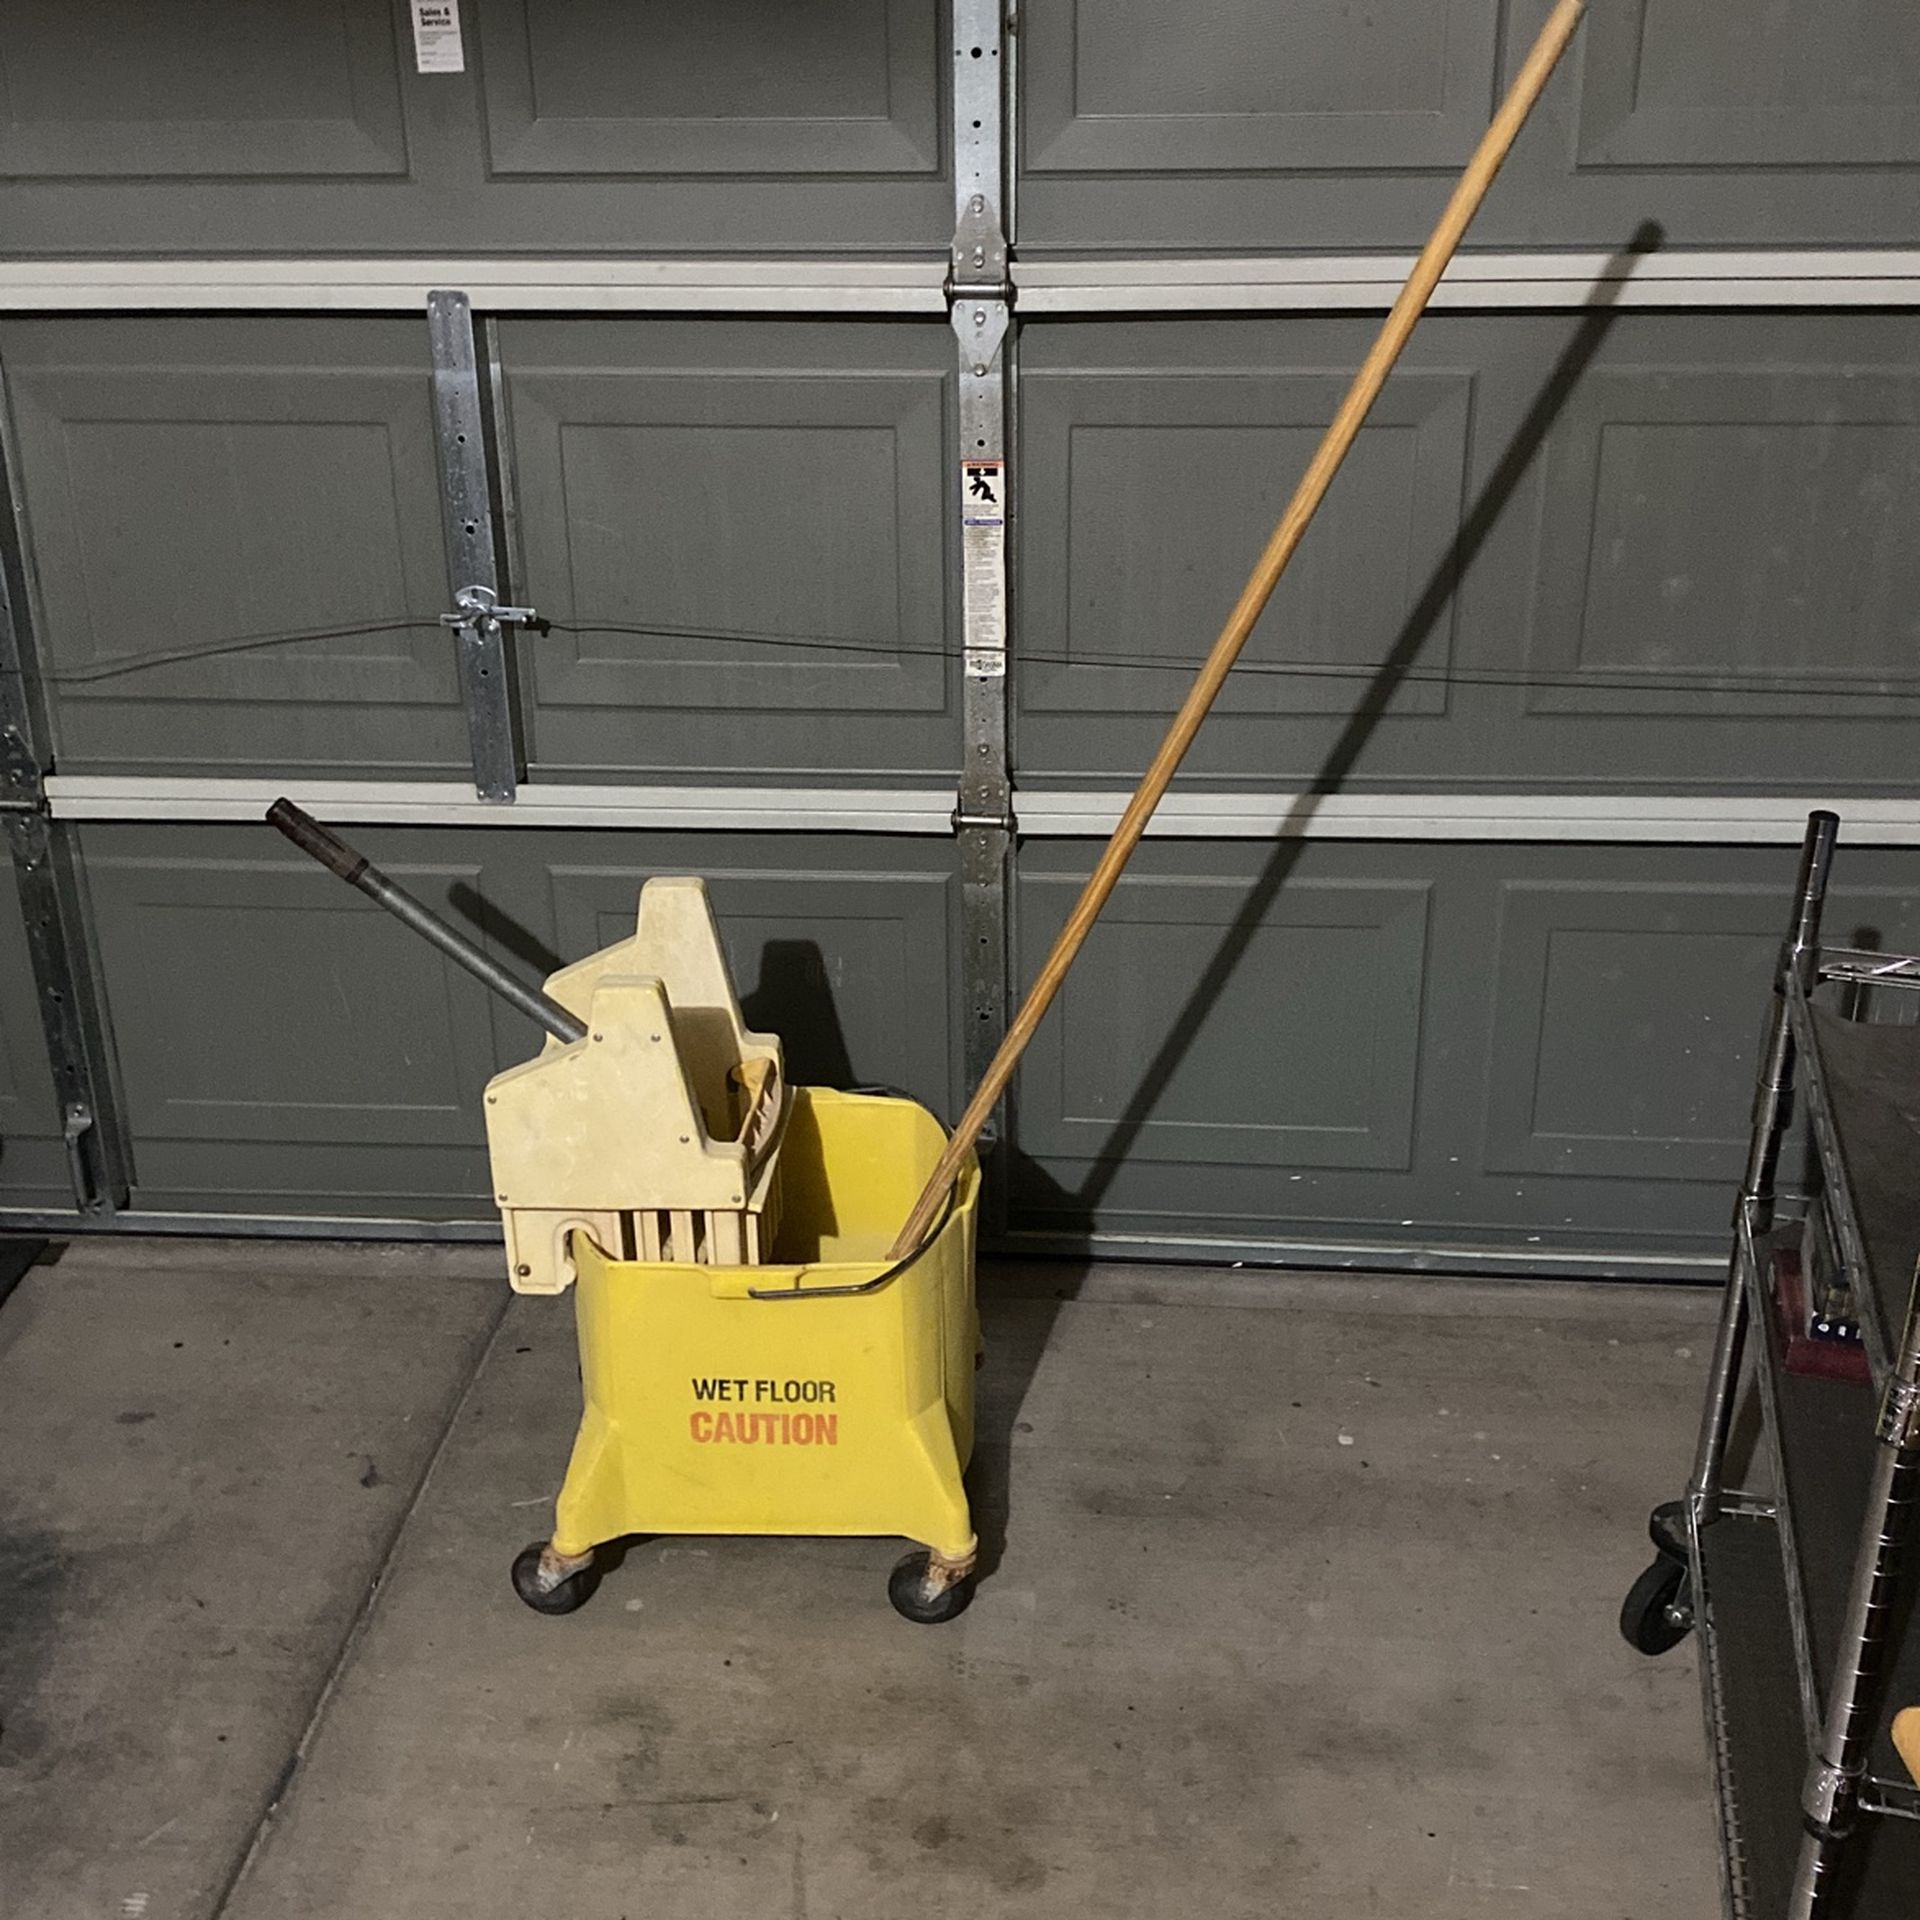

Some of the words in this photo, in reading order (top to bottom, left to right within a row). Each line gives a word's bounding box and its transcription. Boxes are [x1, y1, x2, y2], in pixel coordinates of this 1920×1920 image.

[419, 7, 441, 16] Sales
[421, 18, 451, 26] Service
[692, 1378, 748, 1401] WET
[755, 1380, 836, 1403] FLOOR
[690, 1411, 838, 1446] CAUTION
